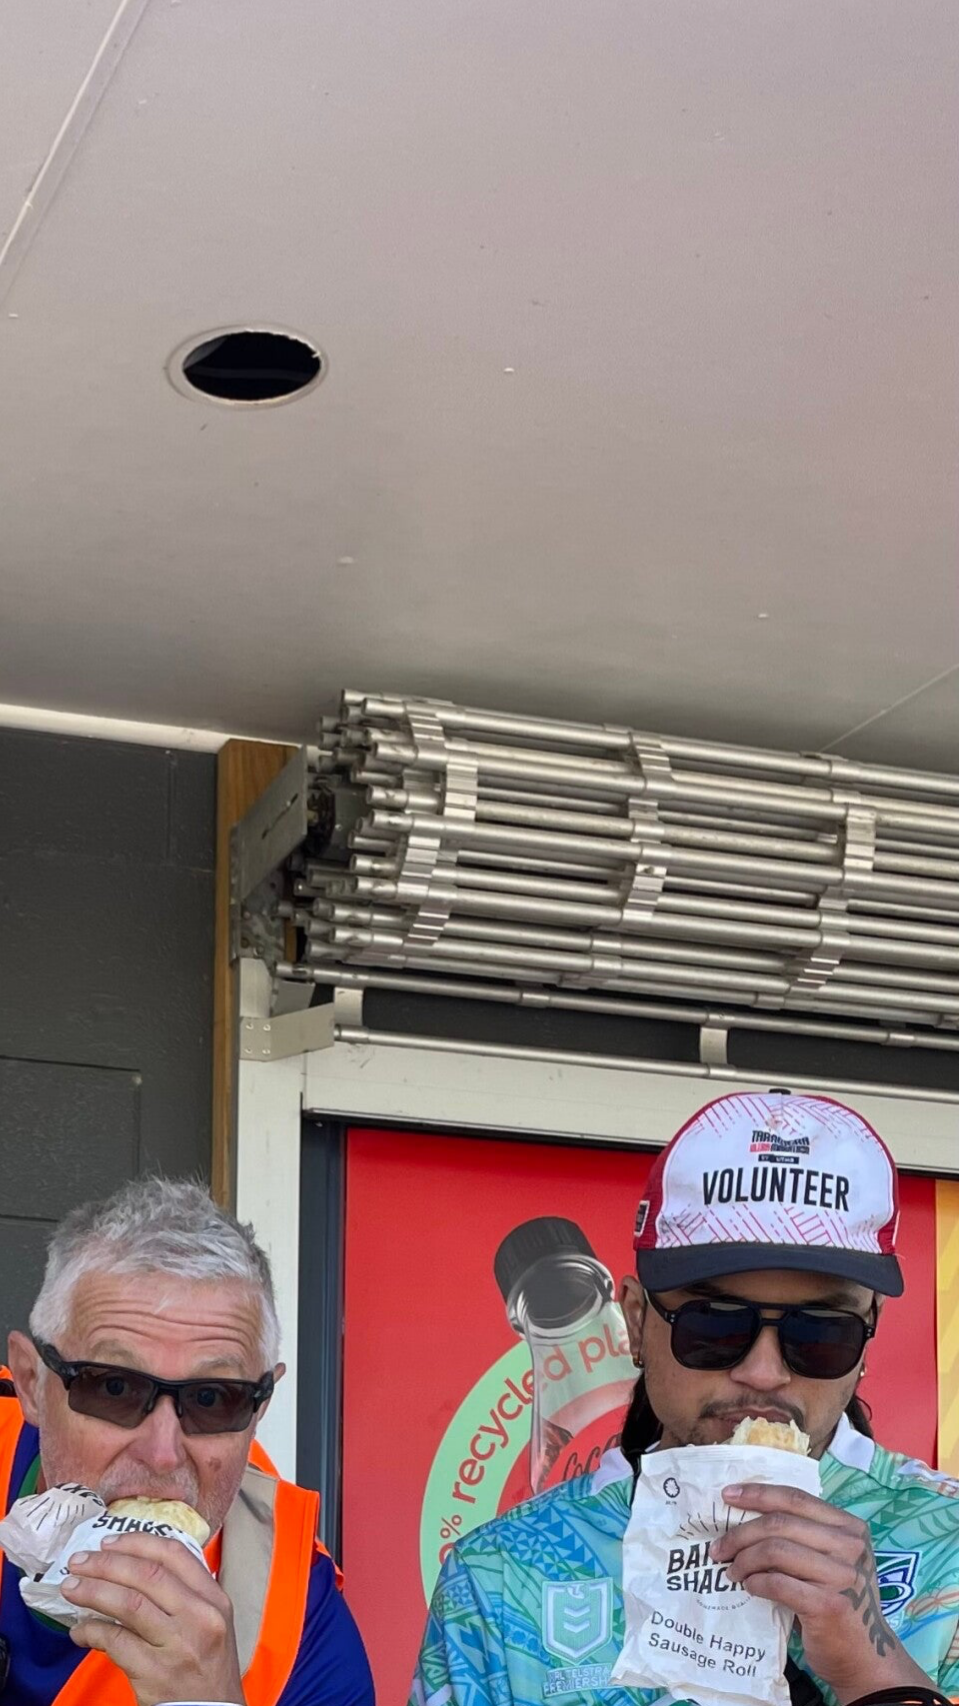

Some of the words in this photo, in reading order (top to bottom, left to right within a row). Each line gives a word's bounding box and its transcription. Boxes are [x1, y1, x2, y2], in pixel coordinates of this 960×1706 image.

[702, 1166, 850, 1213] VOLUNTEER
[451, 1343, 573, 1504] recycled
[648, 1632, 717, 1669] Sausage
[722, 1659, 757, 1678] Roll
[650, 1610, 705, 1645] Double
[709, 1634, 766, 1662] Happy
[543, 1676, 611, 1694] PREMIERSH
[566, 1666, 611, 1679] TELSTRA
